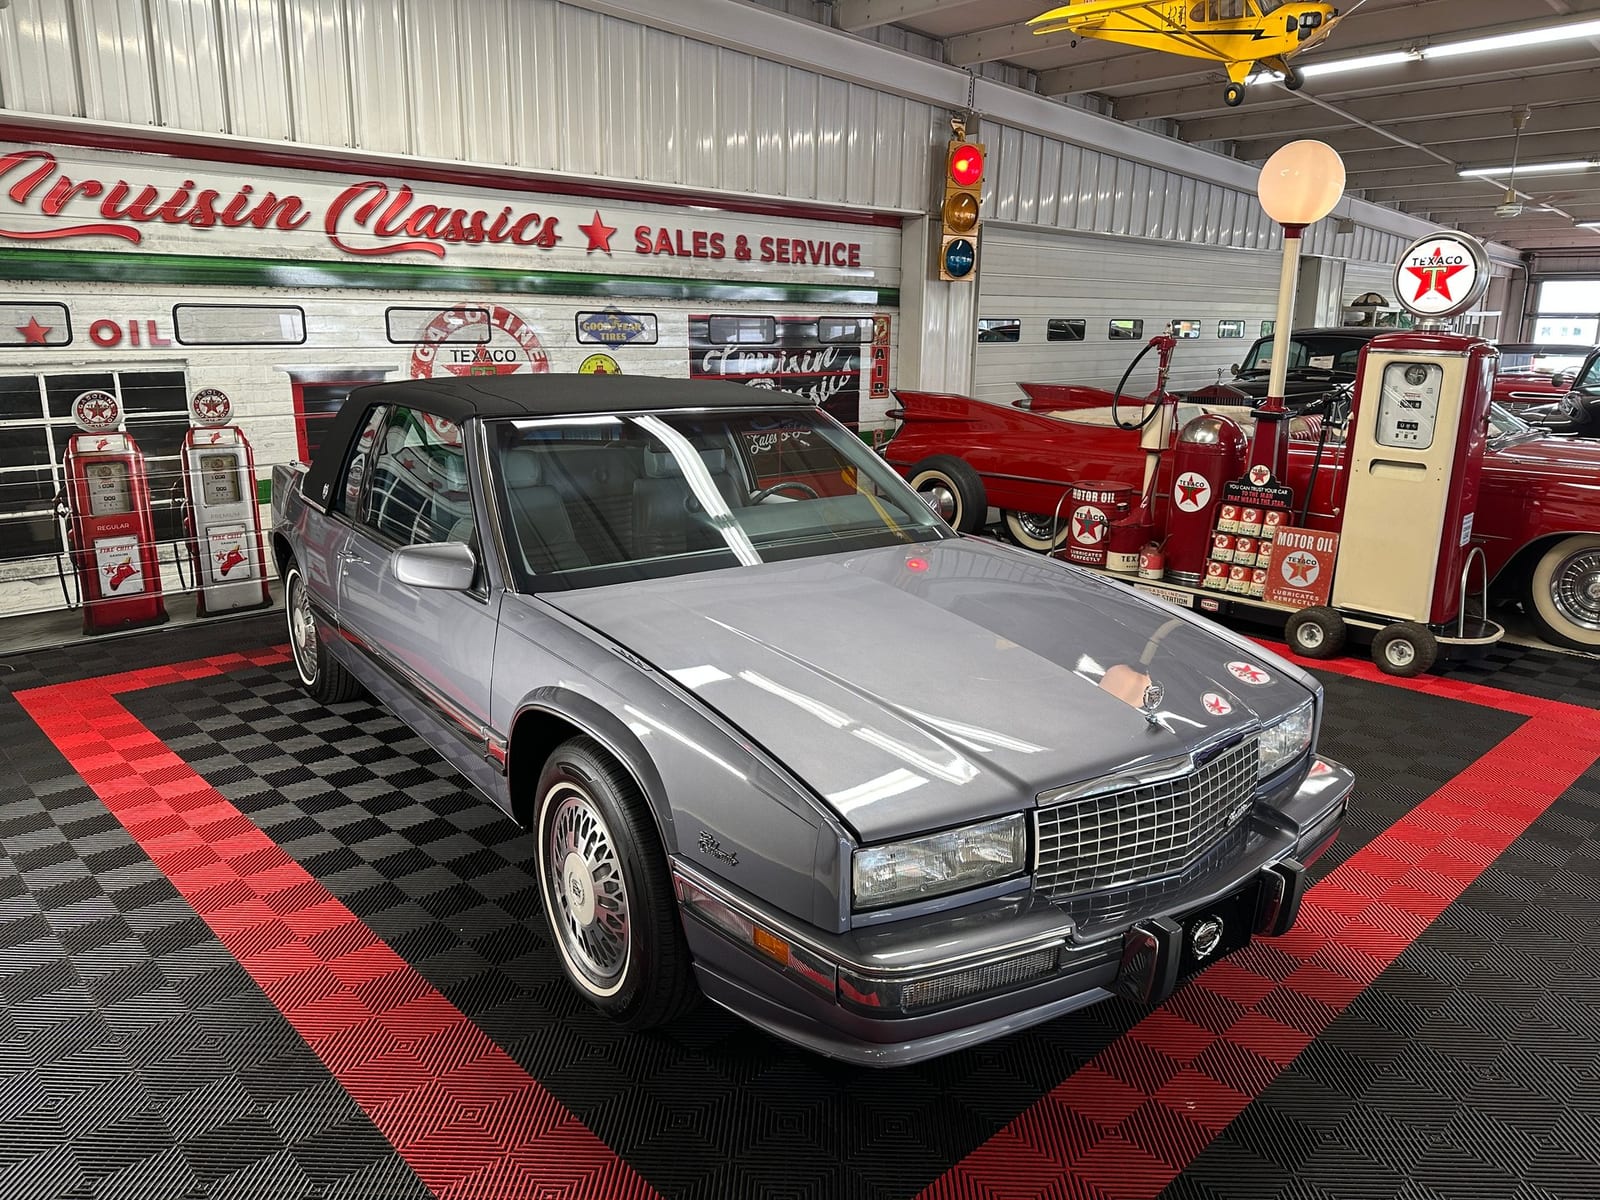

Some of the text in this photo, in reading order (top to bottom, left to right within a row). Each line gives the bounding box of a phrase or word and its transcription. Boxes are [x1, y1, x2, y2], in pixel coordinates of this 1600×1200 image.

[325, 181, 563, 259] Classics
[635, 226, 861, 267] SALES & SERVICE
[1412, 255, 1463, 266] TEXACO
[89, 319, 172, 347] OIL
[415, 304, 546, 362] GASOLINE
[600, 332, 627, 341] TIRES
[451, 350, 517, 363] TEXACO
[873, 347, 886, 393] AIR
[1180, 480, 1205, 488] TEXACO
[1072, 488, 1115, 503] MOTOR OIL
[1076, 511, 1105, 521] TEXACO
[96, 522, 130, 531] REGULAR
[1277, 531, 1333, 552] MOTOR OIL
[1287, 556, 1317, 566] TEXACO
[1272, 589, 1319, 601] LUBRICATES
[1273, 595, 1316, 607] PERFECTLY
